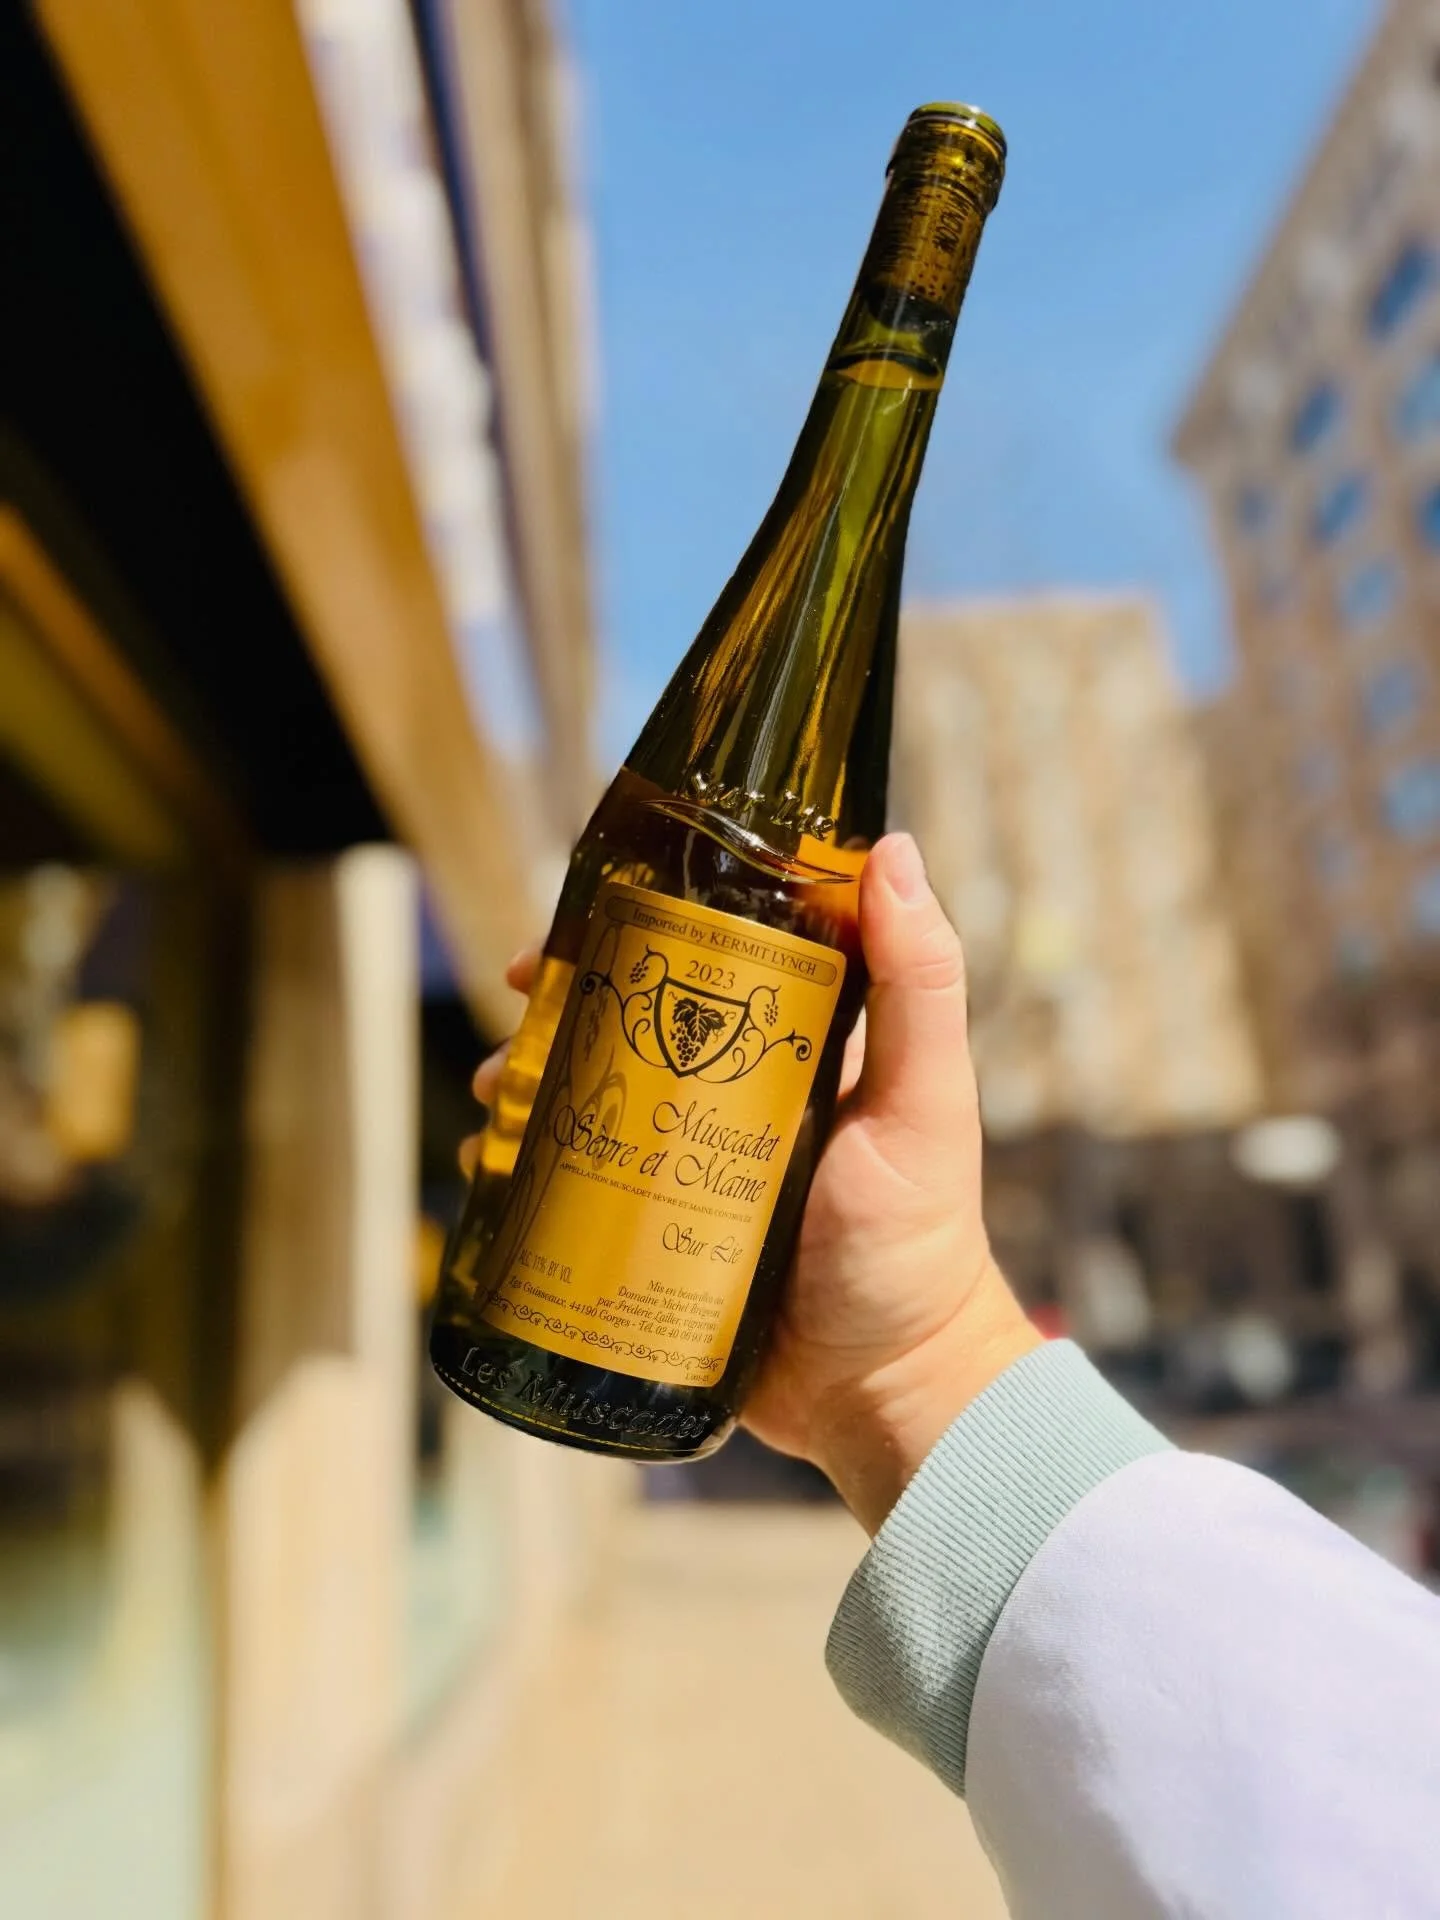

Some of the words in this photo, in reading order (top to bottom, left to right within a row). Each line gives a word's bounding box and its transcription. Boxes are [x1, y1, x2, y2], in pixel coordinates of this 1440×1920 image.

[632, 908, 688, 936] Imported
[690, 925, 706, 941] by
[709, 931, 770, 965] KERMIT
[770, 950, 817, 976] LYNCH
[685, 959, 736, 990] 2023
[652, 1100, 781, 1162] Muscadet
[553, 1104, 639, 1167] Sèvre
[639, 1149, 669, 1177] et
[674, 1152, 767, 1203] Maine
[559, 1162, 609, 1184] APPELLATION
[609, 1179, 651, 1199] MUSCADET
[678, 1200, 688, 1209] ET
[689, 1203, 713, 1216] MAINE
[662, 1222, 707, 1257] Sur
[710, 1235, 744, 1265] Lie
[547, 1260, 560, 1277] BY
[647, 1280, 665, 1294] Mis
[665, 1287, 677, 1296] en
[568, 1301, 597, 1318] 44190
[599, 1309, 631, 1329] Gorges
[655, 1325, 668, 1336] 02
[597, 1297, 615, 1308] par
[618, 1286, 660, 1306] Domaine
[661, 1298, 689, 1312] Michel
[459, 1346, 511, 1391] Les
